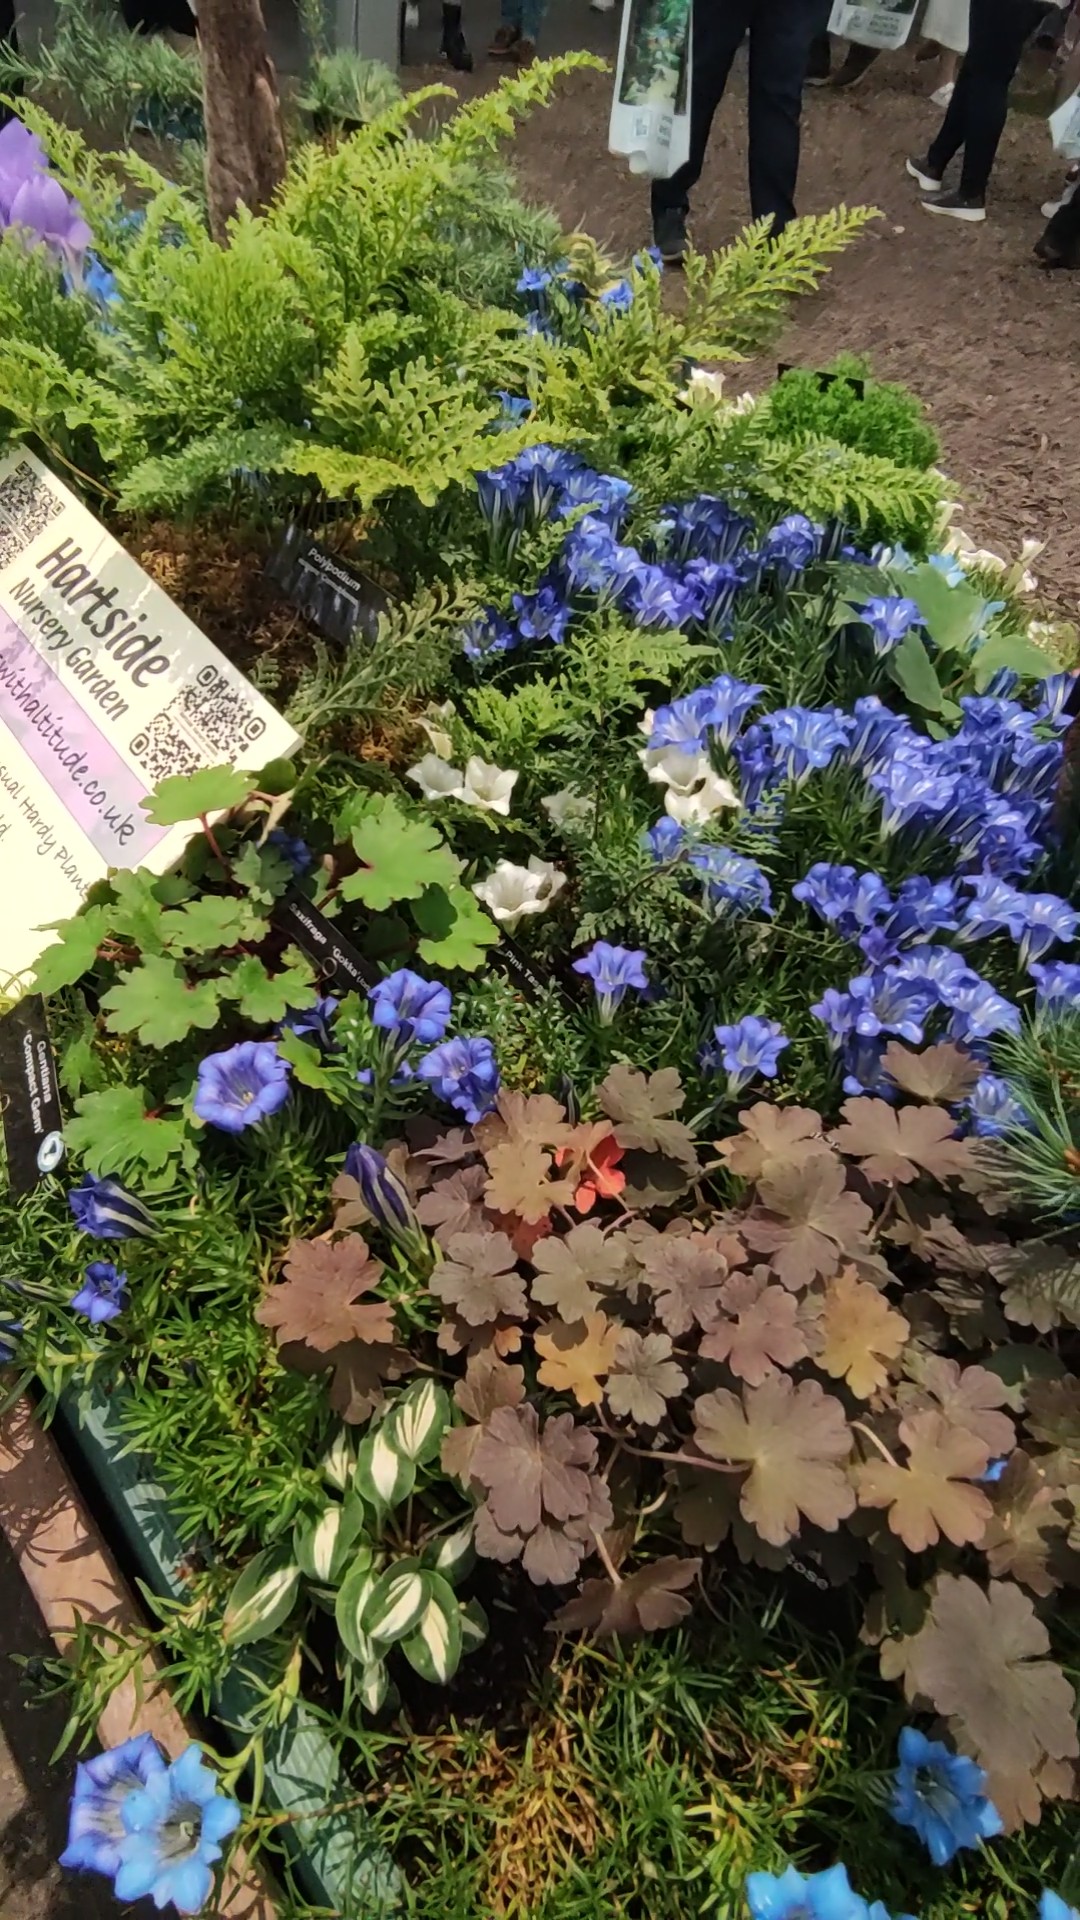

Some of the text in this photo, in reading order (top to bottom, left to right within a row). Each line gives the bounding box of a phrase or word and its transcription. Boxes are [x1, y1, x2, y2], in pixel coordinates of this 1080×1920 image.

[308, 548, 361, 591] Polypodium
[9, 577, 73, 651] Nursery
[65, 646, 129, 722] Garden
[35, 537, 171, 688] Hartside
[0, 654, 135, 846] withaltitude.co.uk
[19, 796, 57, 855] Hardy
[54, 845, 90, 897] Plant
[289, 902, 328, 945] Saxifraga
[505, 950, 524, 971] Pink
[36, 1040, 52, 1104] Gentiana
